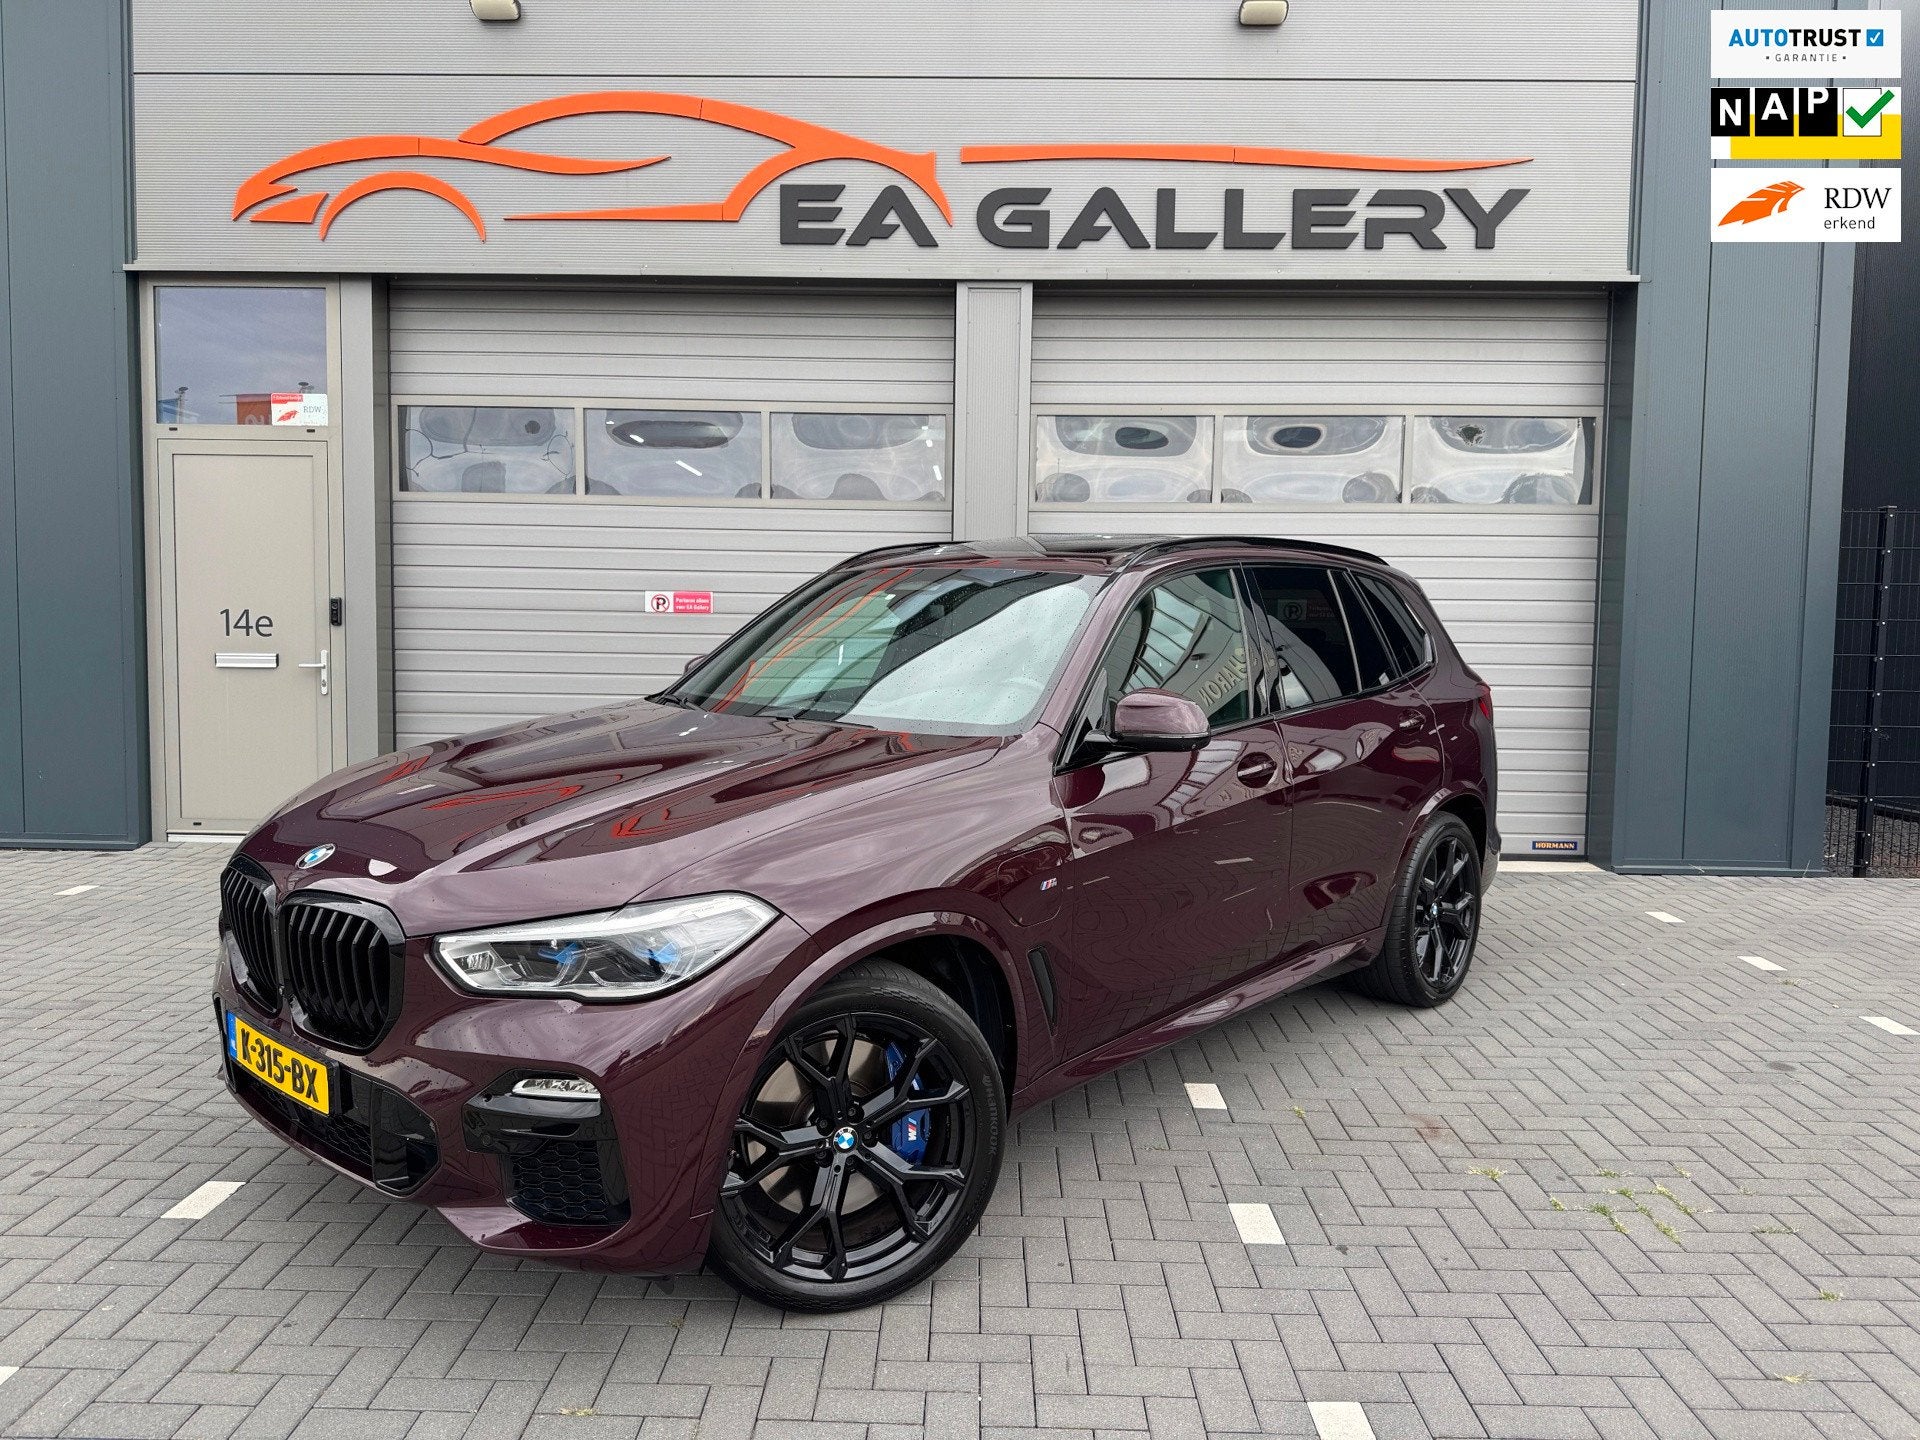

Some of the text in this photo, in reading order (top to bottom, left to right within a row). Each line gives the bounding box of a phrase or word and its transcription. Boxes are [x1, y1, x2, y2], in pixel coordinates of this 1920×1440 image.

[780, 184, 1532, 250] EA GALLERY
[303, 405, 322, 413] RDW
[219, 608, 274, 637] 14e
[240, 1027, 319, 1104] K-315-BX
